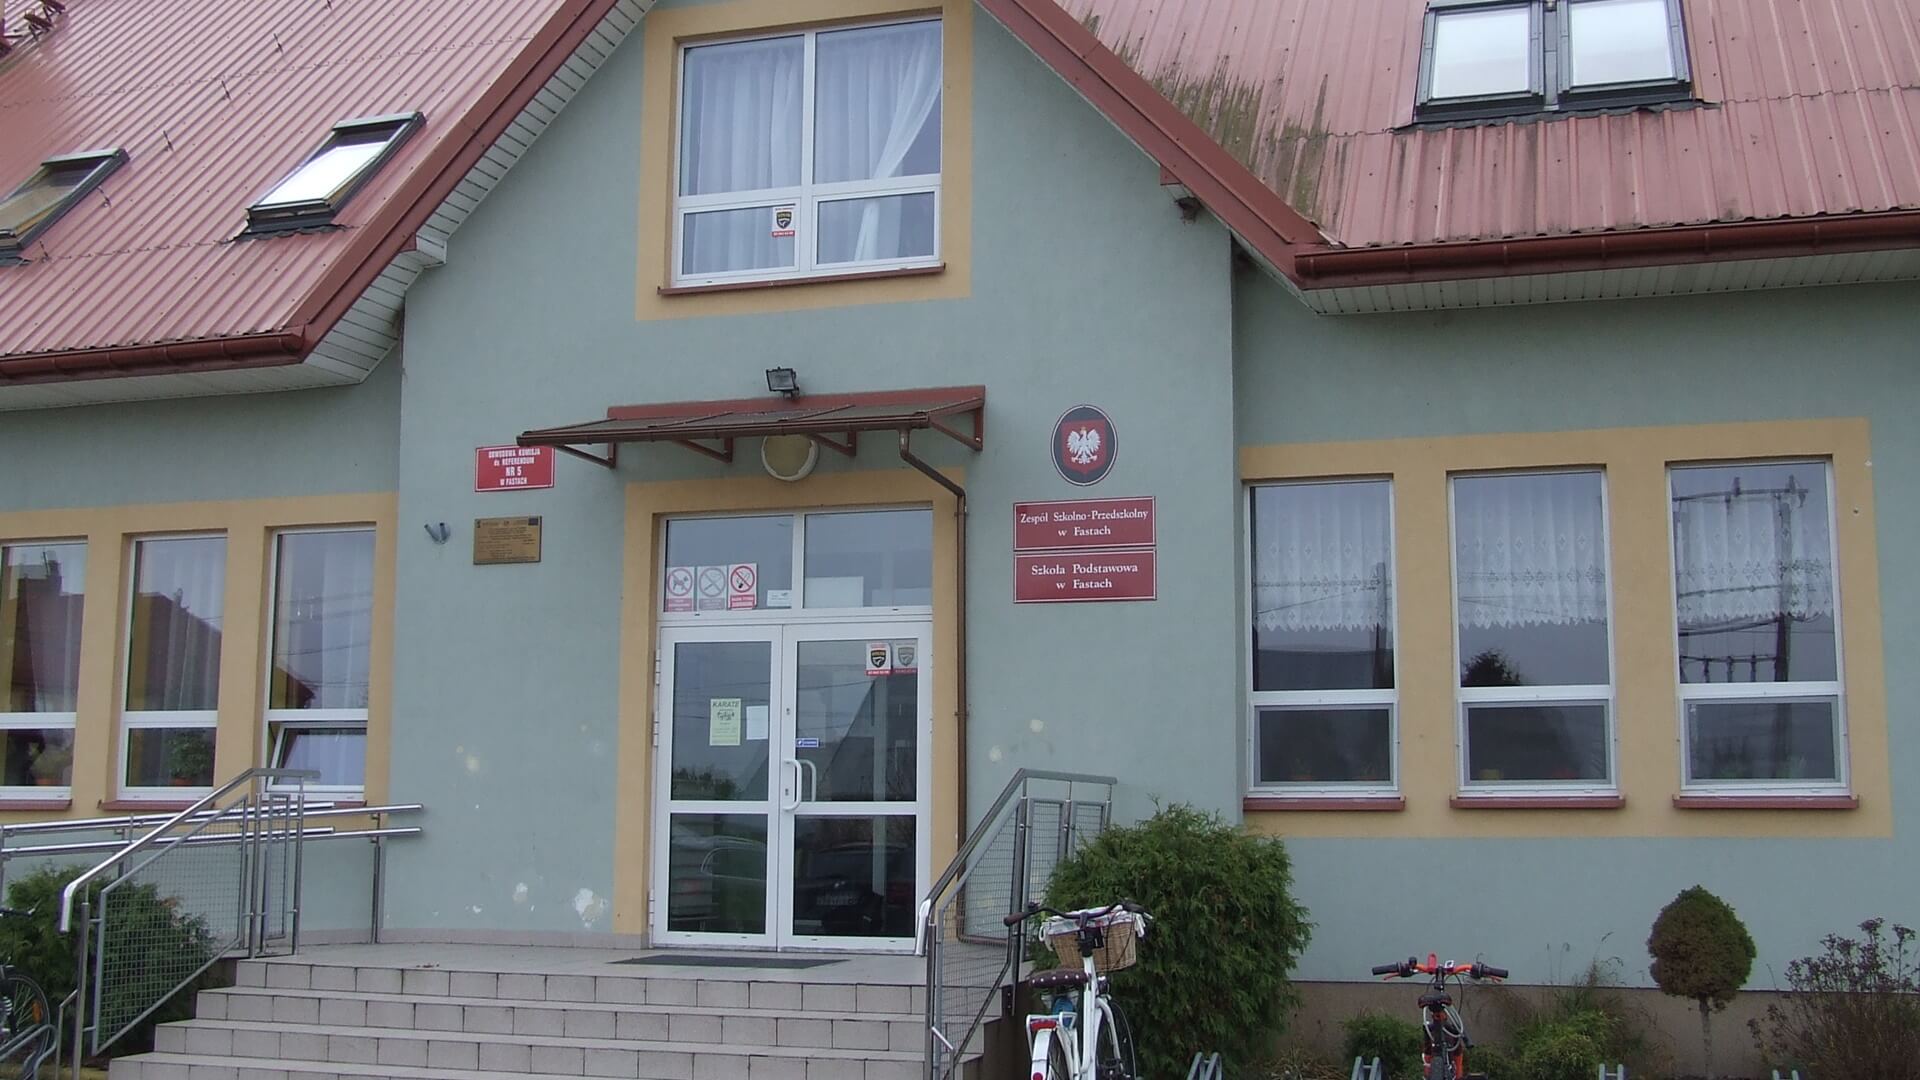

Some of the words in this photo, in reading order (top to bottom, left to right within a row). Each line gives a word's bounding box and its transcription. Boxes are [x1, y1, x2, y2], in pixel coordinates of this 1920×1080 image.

[518, 448, 541, 456] KOMISJA
[502, 457, 535, 465] REFERENDUM
[505, 467, 515, 476] NR
[516, 466, 522, 476] 5
[1053, 508, 1148, 521] Szkolno-Przedszkolny
[1074, 525, 1111, 536] Fastach
[1072, 563, 1138, 574] Podstawowa
[1073, 578, 1112, 588] Fastach
